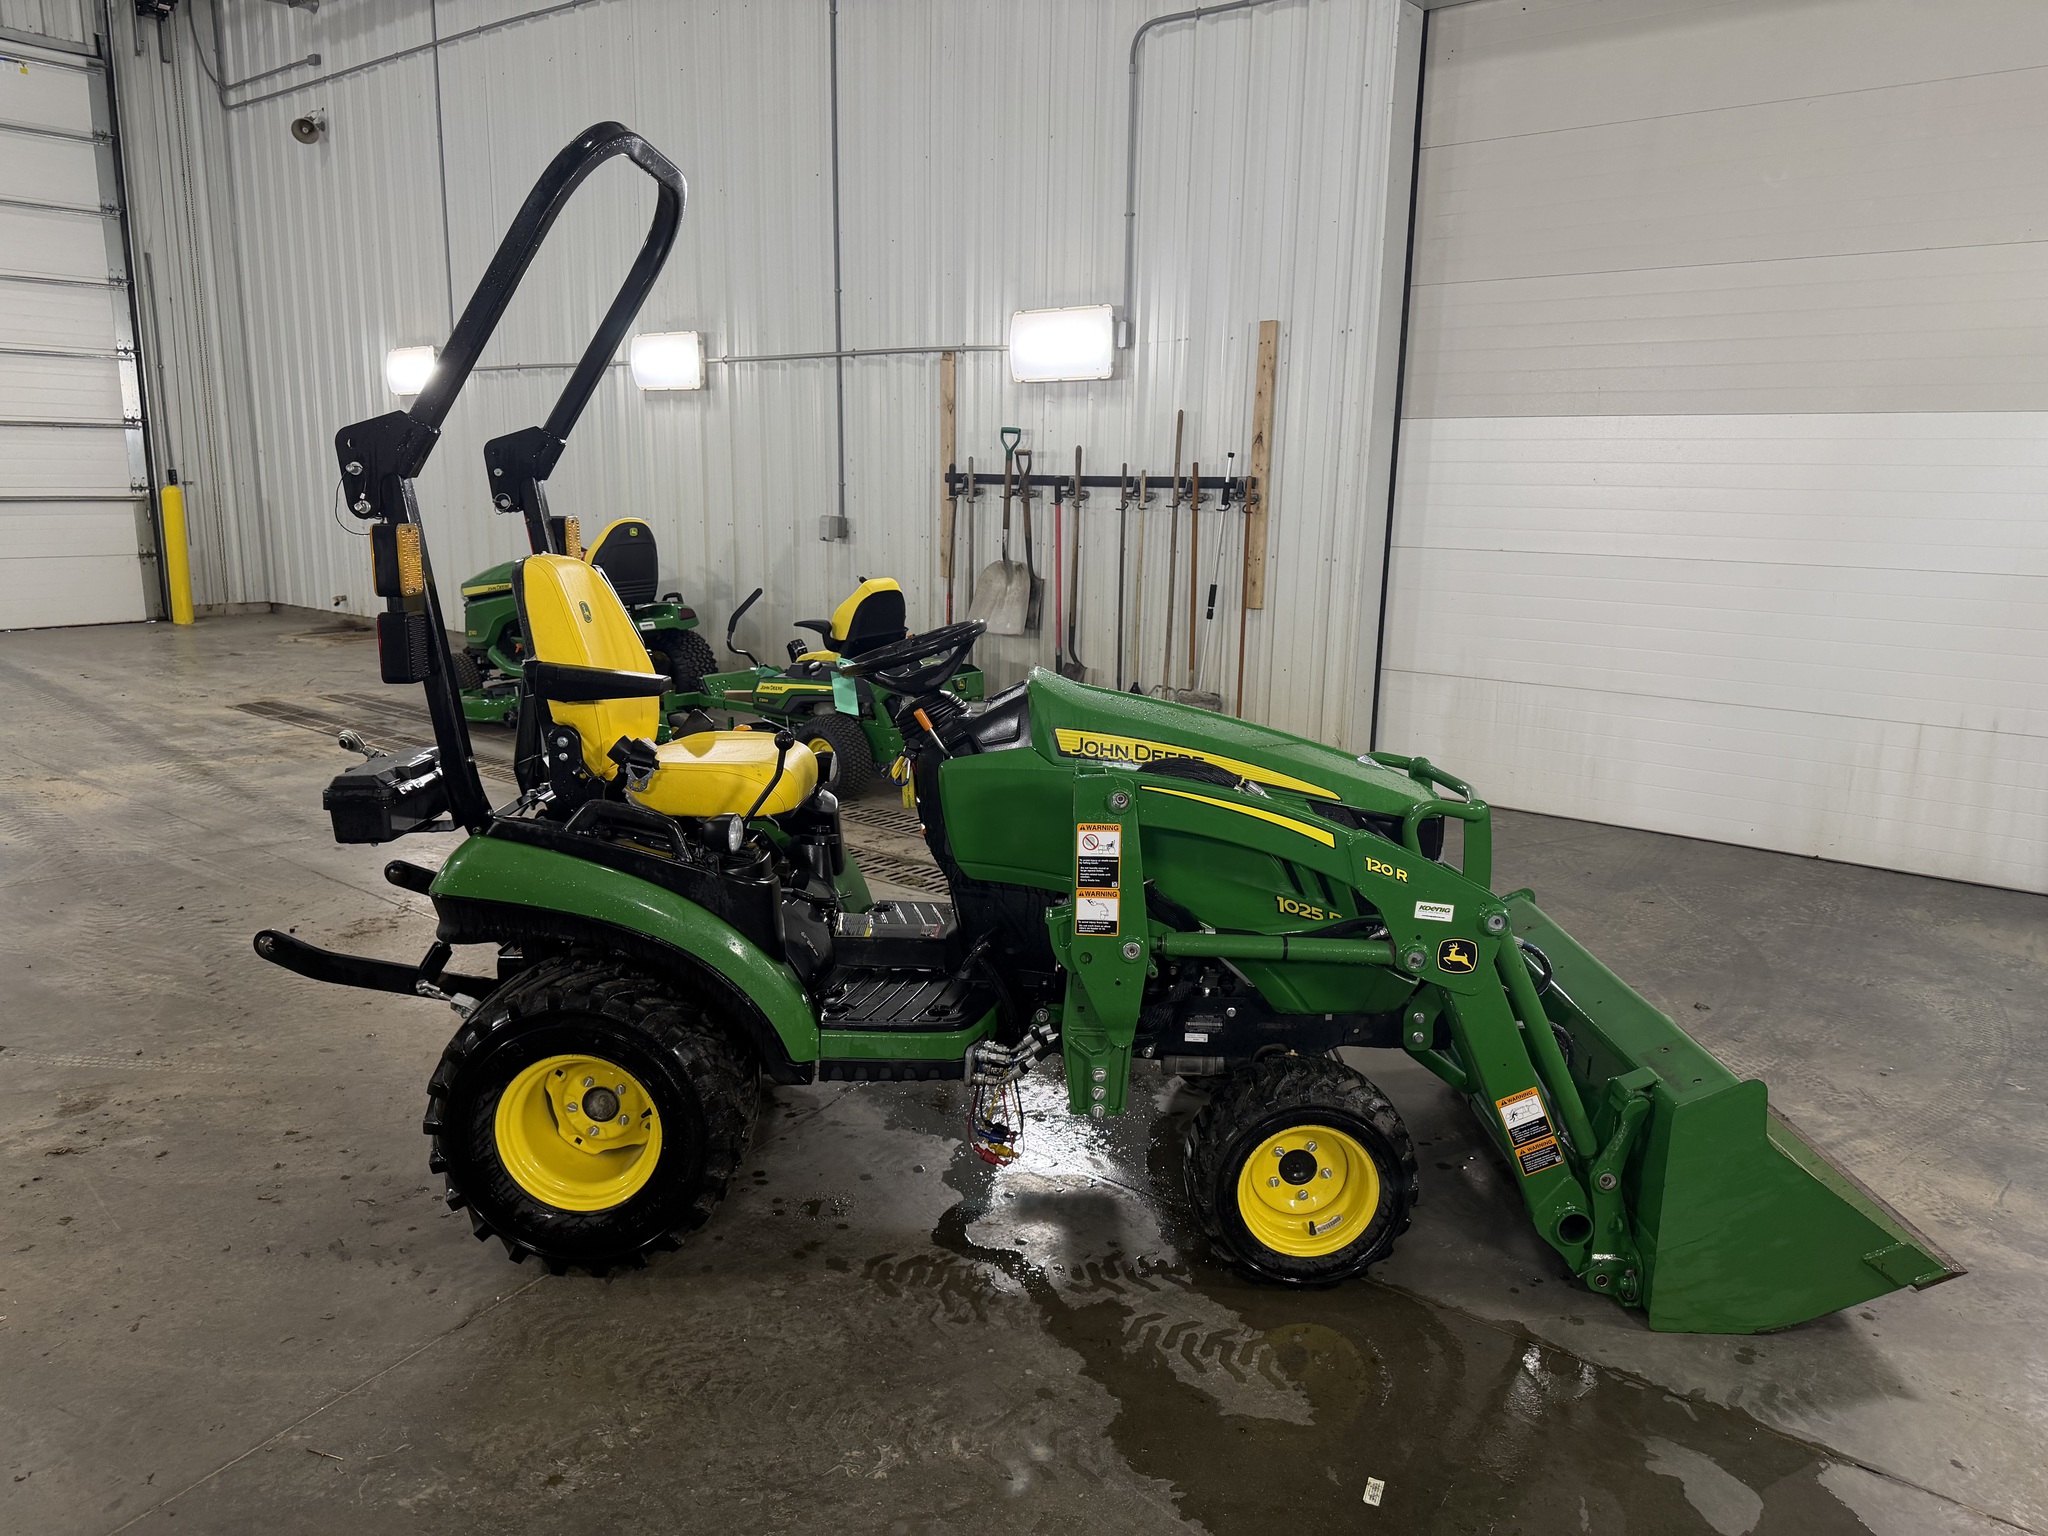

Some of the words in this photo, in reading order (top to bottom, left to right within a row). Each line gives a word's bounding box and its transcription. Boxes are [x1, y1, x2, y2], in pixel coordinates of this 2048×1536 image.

[1072, 737, 1129, 759] JOHN
[1364, 857, 1394, 877] 120
[1396, 868, 1409, 884] R
[1275, 895, 1325, 921] 1025
[1507, 1091, 1533, 1103] WARNING
[1527, 1140, 1553, 1152] WARNING
